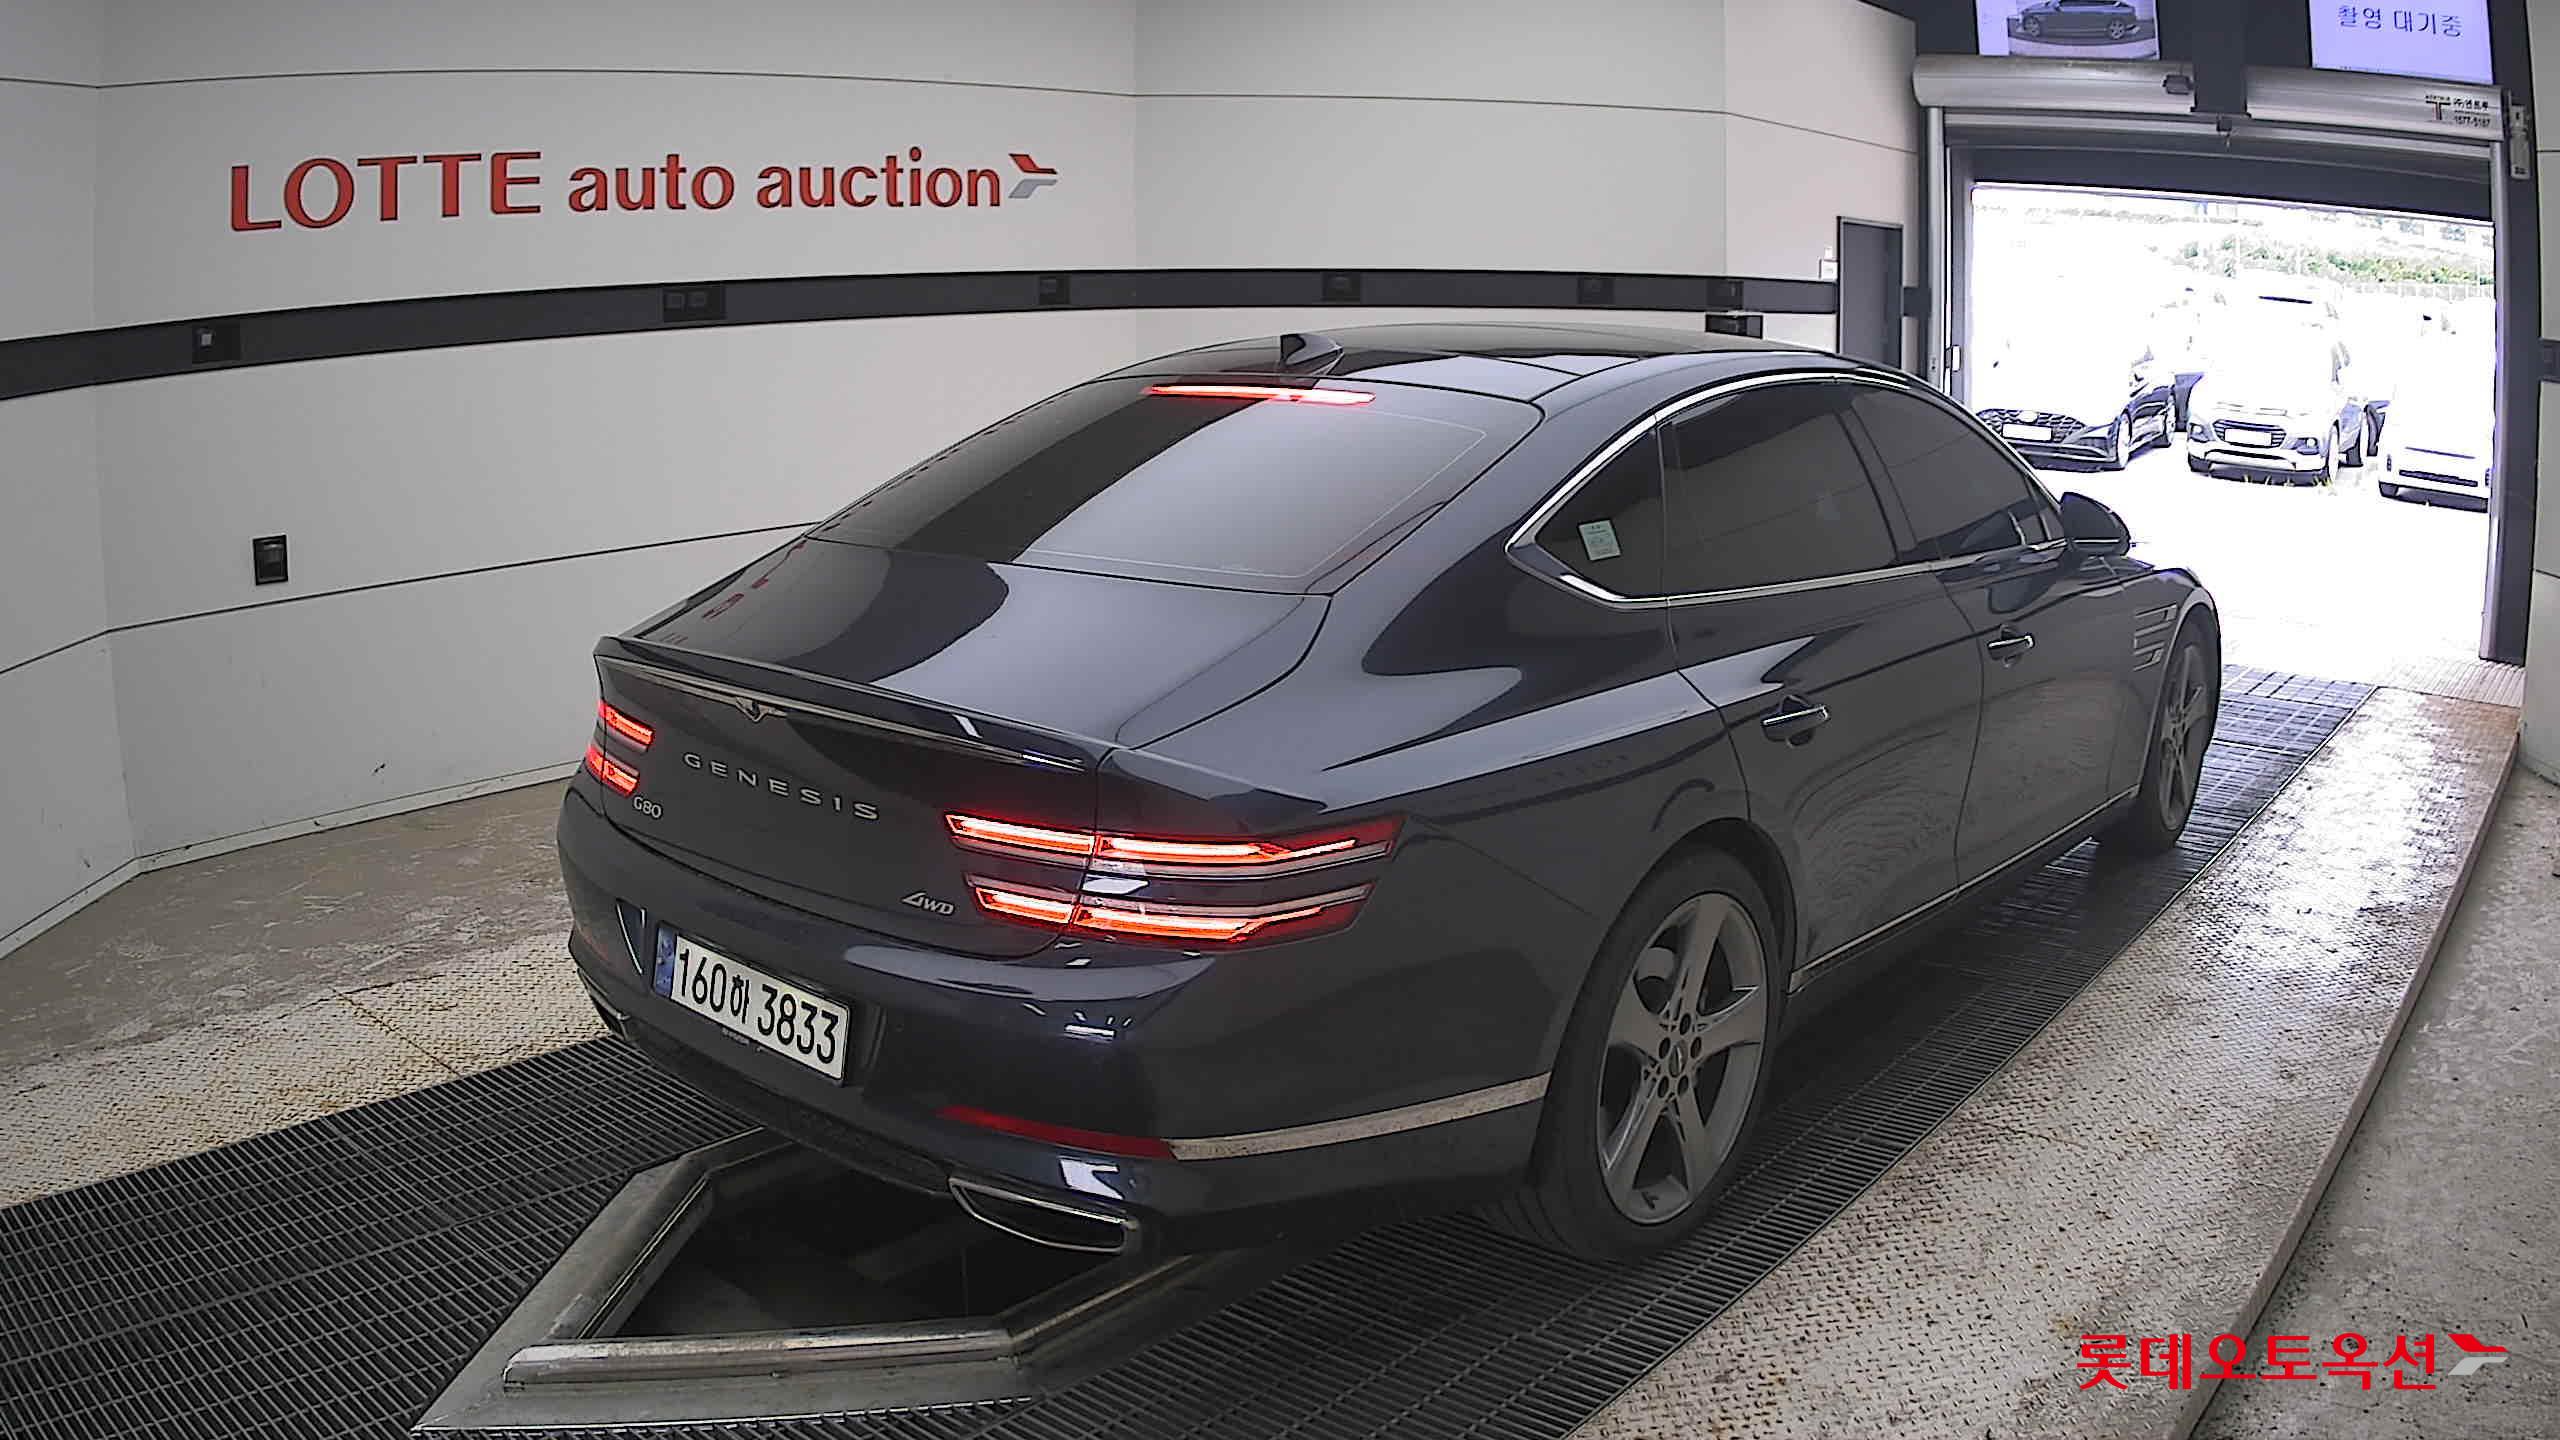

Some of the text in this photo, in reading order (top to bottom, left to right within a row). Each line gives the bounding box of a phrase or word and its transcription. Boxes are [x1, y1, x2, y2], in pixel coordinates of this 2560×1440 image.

[2339, 5, 2463, 38] 촬영 대기중
[231, 146, 1001, 232] LOTTE auto auction
[633, 795, 662, 819] G80
[683, 753, 878, 820] GENESIS
[902, 892, 955, 915] 4WD
[679, 948, 839, 1064] 160하 3833
